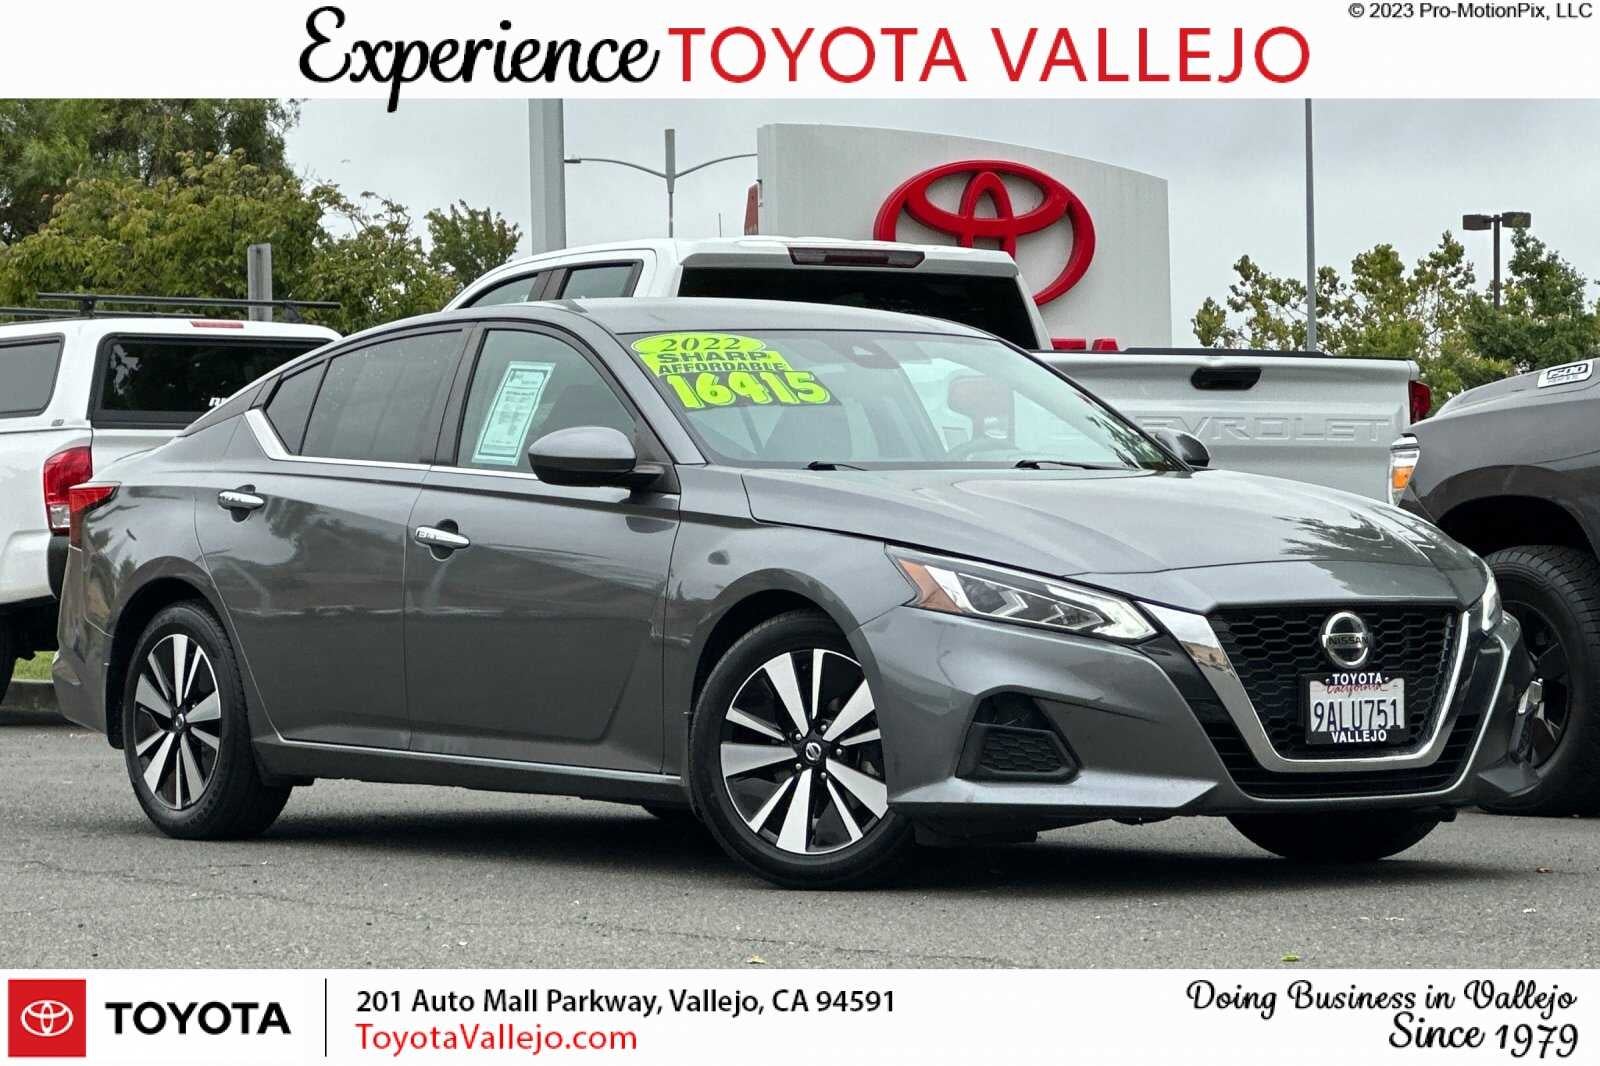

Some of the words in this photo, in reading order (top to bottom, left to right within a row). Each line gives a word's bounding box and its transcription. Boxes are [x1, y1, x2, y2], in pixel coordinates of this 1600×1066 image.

[660, 337, 742, 352] 2022
[656, 351, 770, 363] SHARP
[658, 361, 785, 375] AFFORDABLE
[666, 371, 831, 409] 16415
[1134, 415, 1390, 443] EVROLET
[1332, 672, 1383, 685] TOYOTA
[1313, 699, 1399, 731] 9ALU751
[1331, 730, 1387, 743] VALLEJO
